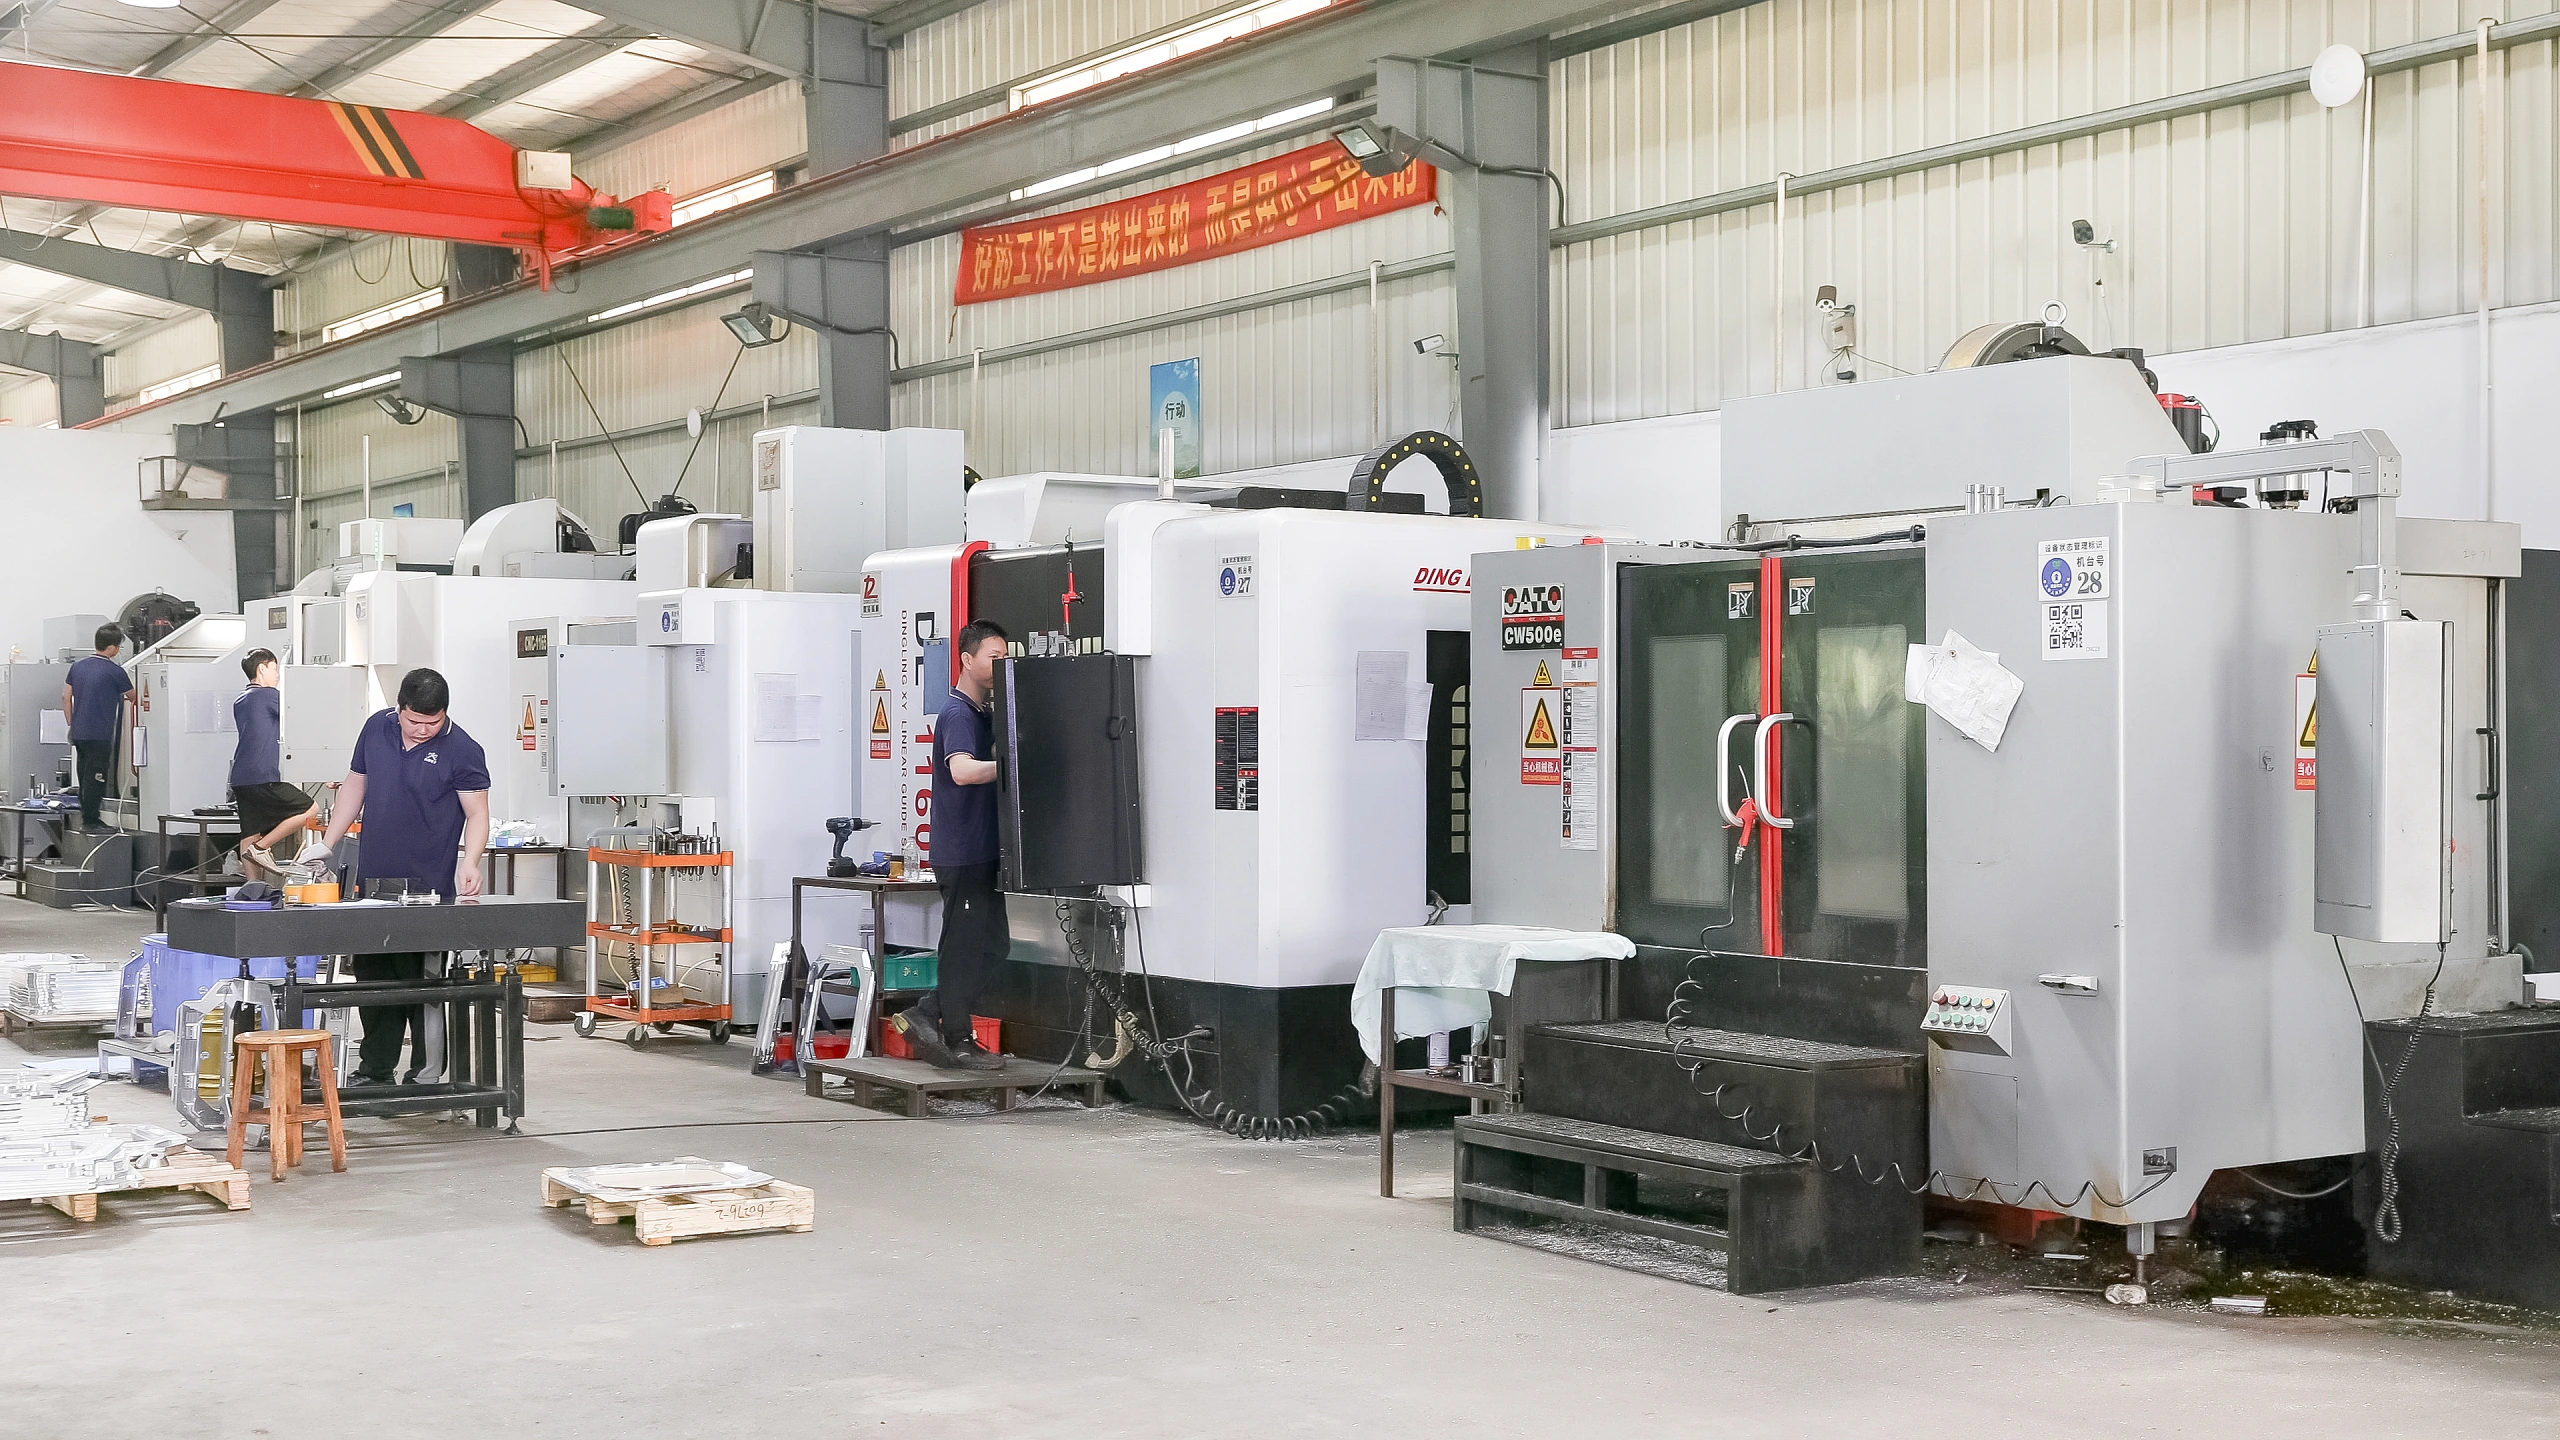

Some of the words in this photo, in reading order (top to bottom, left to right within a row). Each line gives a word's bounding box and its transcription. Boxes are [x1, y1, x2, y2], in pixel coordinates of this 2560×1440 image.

[972, 195, 1190, 293] 好的工作不是找出来的
[1165, 400, 1186, 420] 行动
[2077, 555, 2104, 567] 机台号
[1238, 577, 1250, 593] 27
[1414, 568, 1462, 586] DING
[2078, 571, 2102, 594] 28
[1505, 586, 1561, 613] CATO
[1505, 626, 1561, 644] CW500e
[901, 691, 907, 710] XY
[1523, 761, 1560, 774] 当心机械伤人
[915, 724, 935, 868] 1160
